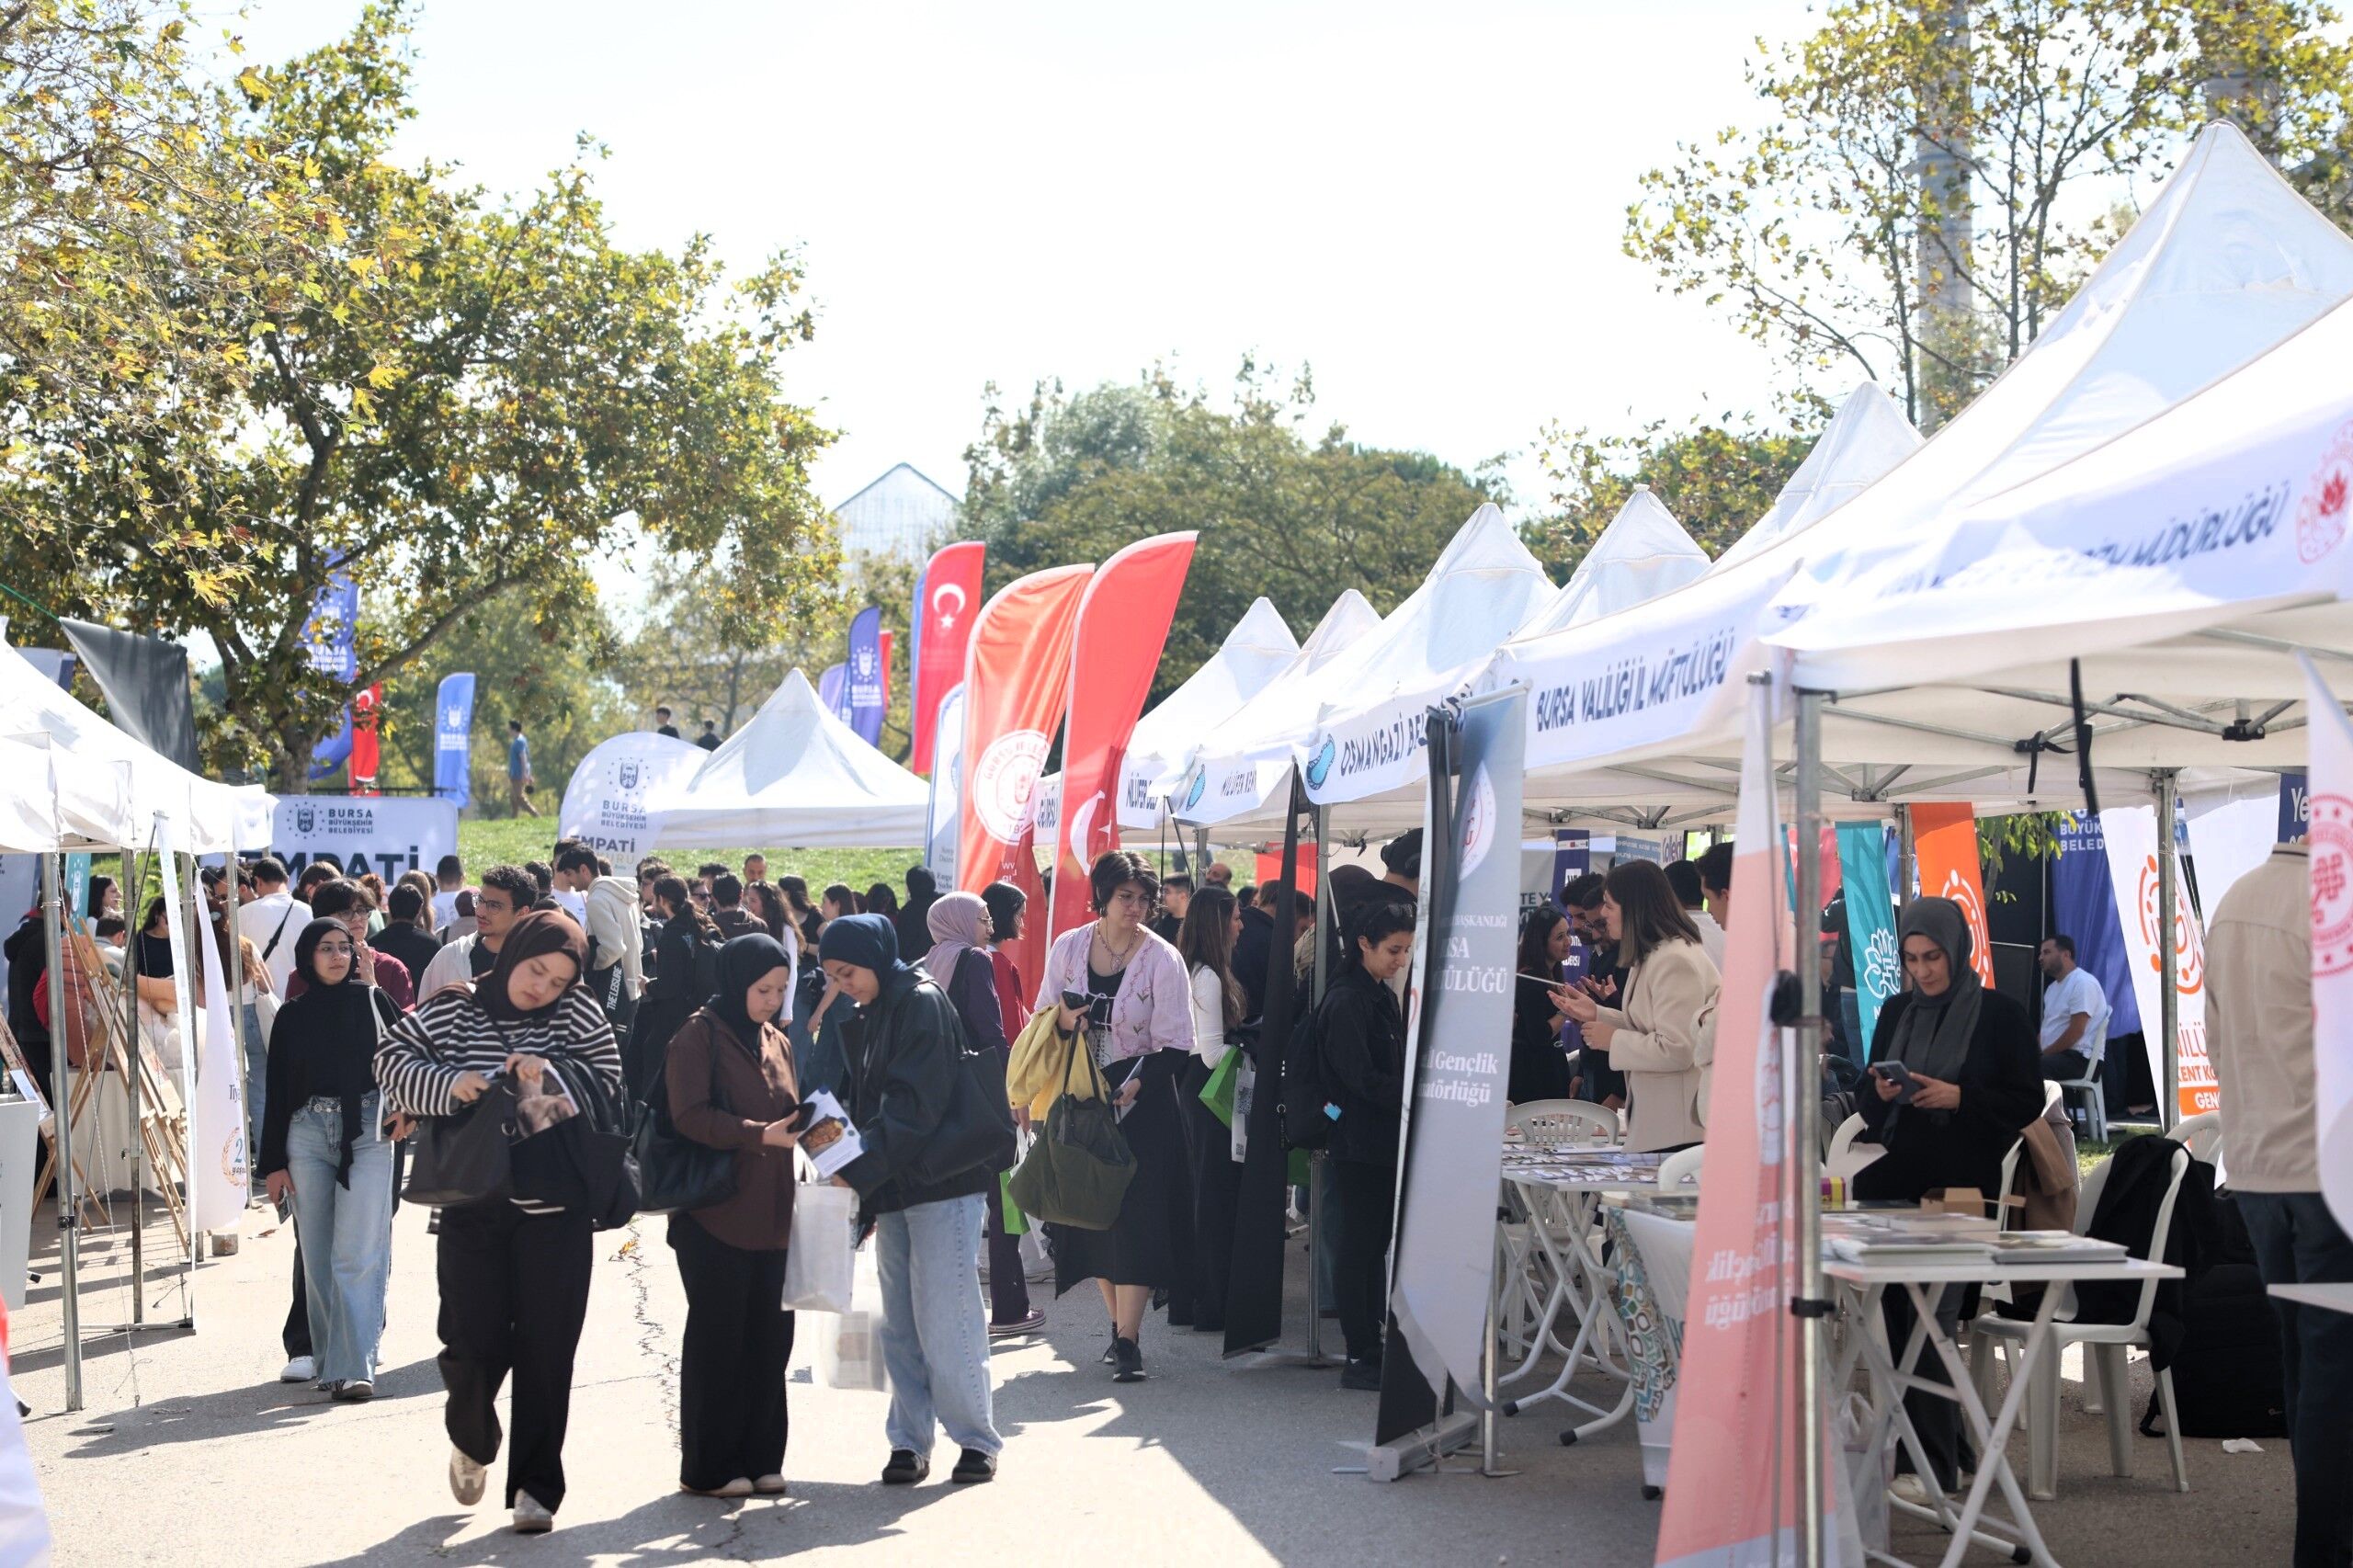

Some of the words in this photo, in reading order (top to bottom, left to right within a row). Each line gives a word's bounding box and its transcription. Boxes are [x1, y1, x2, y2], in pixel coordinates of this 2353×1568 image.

[1537, 685, 1576, 733] BURSA
[1581, 658, 1636, 723] VALİLİĞİ
[1632, 655, 1646, 711] İL
[1647, 627, 1735, 708] MÜFTÜLÜĞÜ
[1340, 710, 1404, 777] OSMANGAZİ
[328, 808, 373, 818] BURSA
[603, 800, 646, 813] BURSA
[328, 818, 373, 827] BÜYÜKŞEHİR
[328, 826, 373, 835] BELEDİYESİ
[239, 846, 419, 888] MATİ
[609, 965, 622, 995] LEISURE
[607, 994, 619, 1010] THE
[1436, 1051, 1498, 1076] Gençlik
